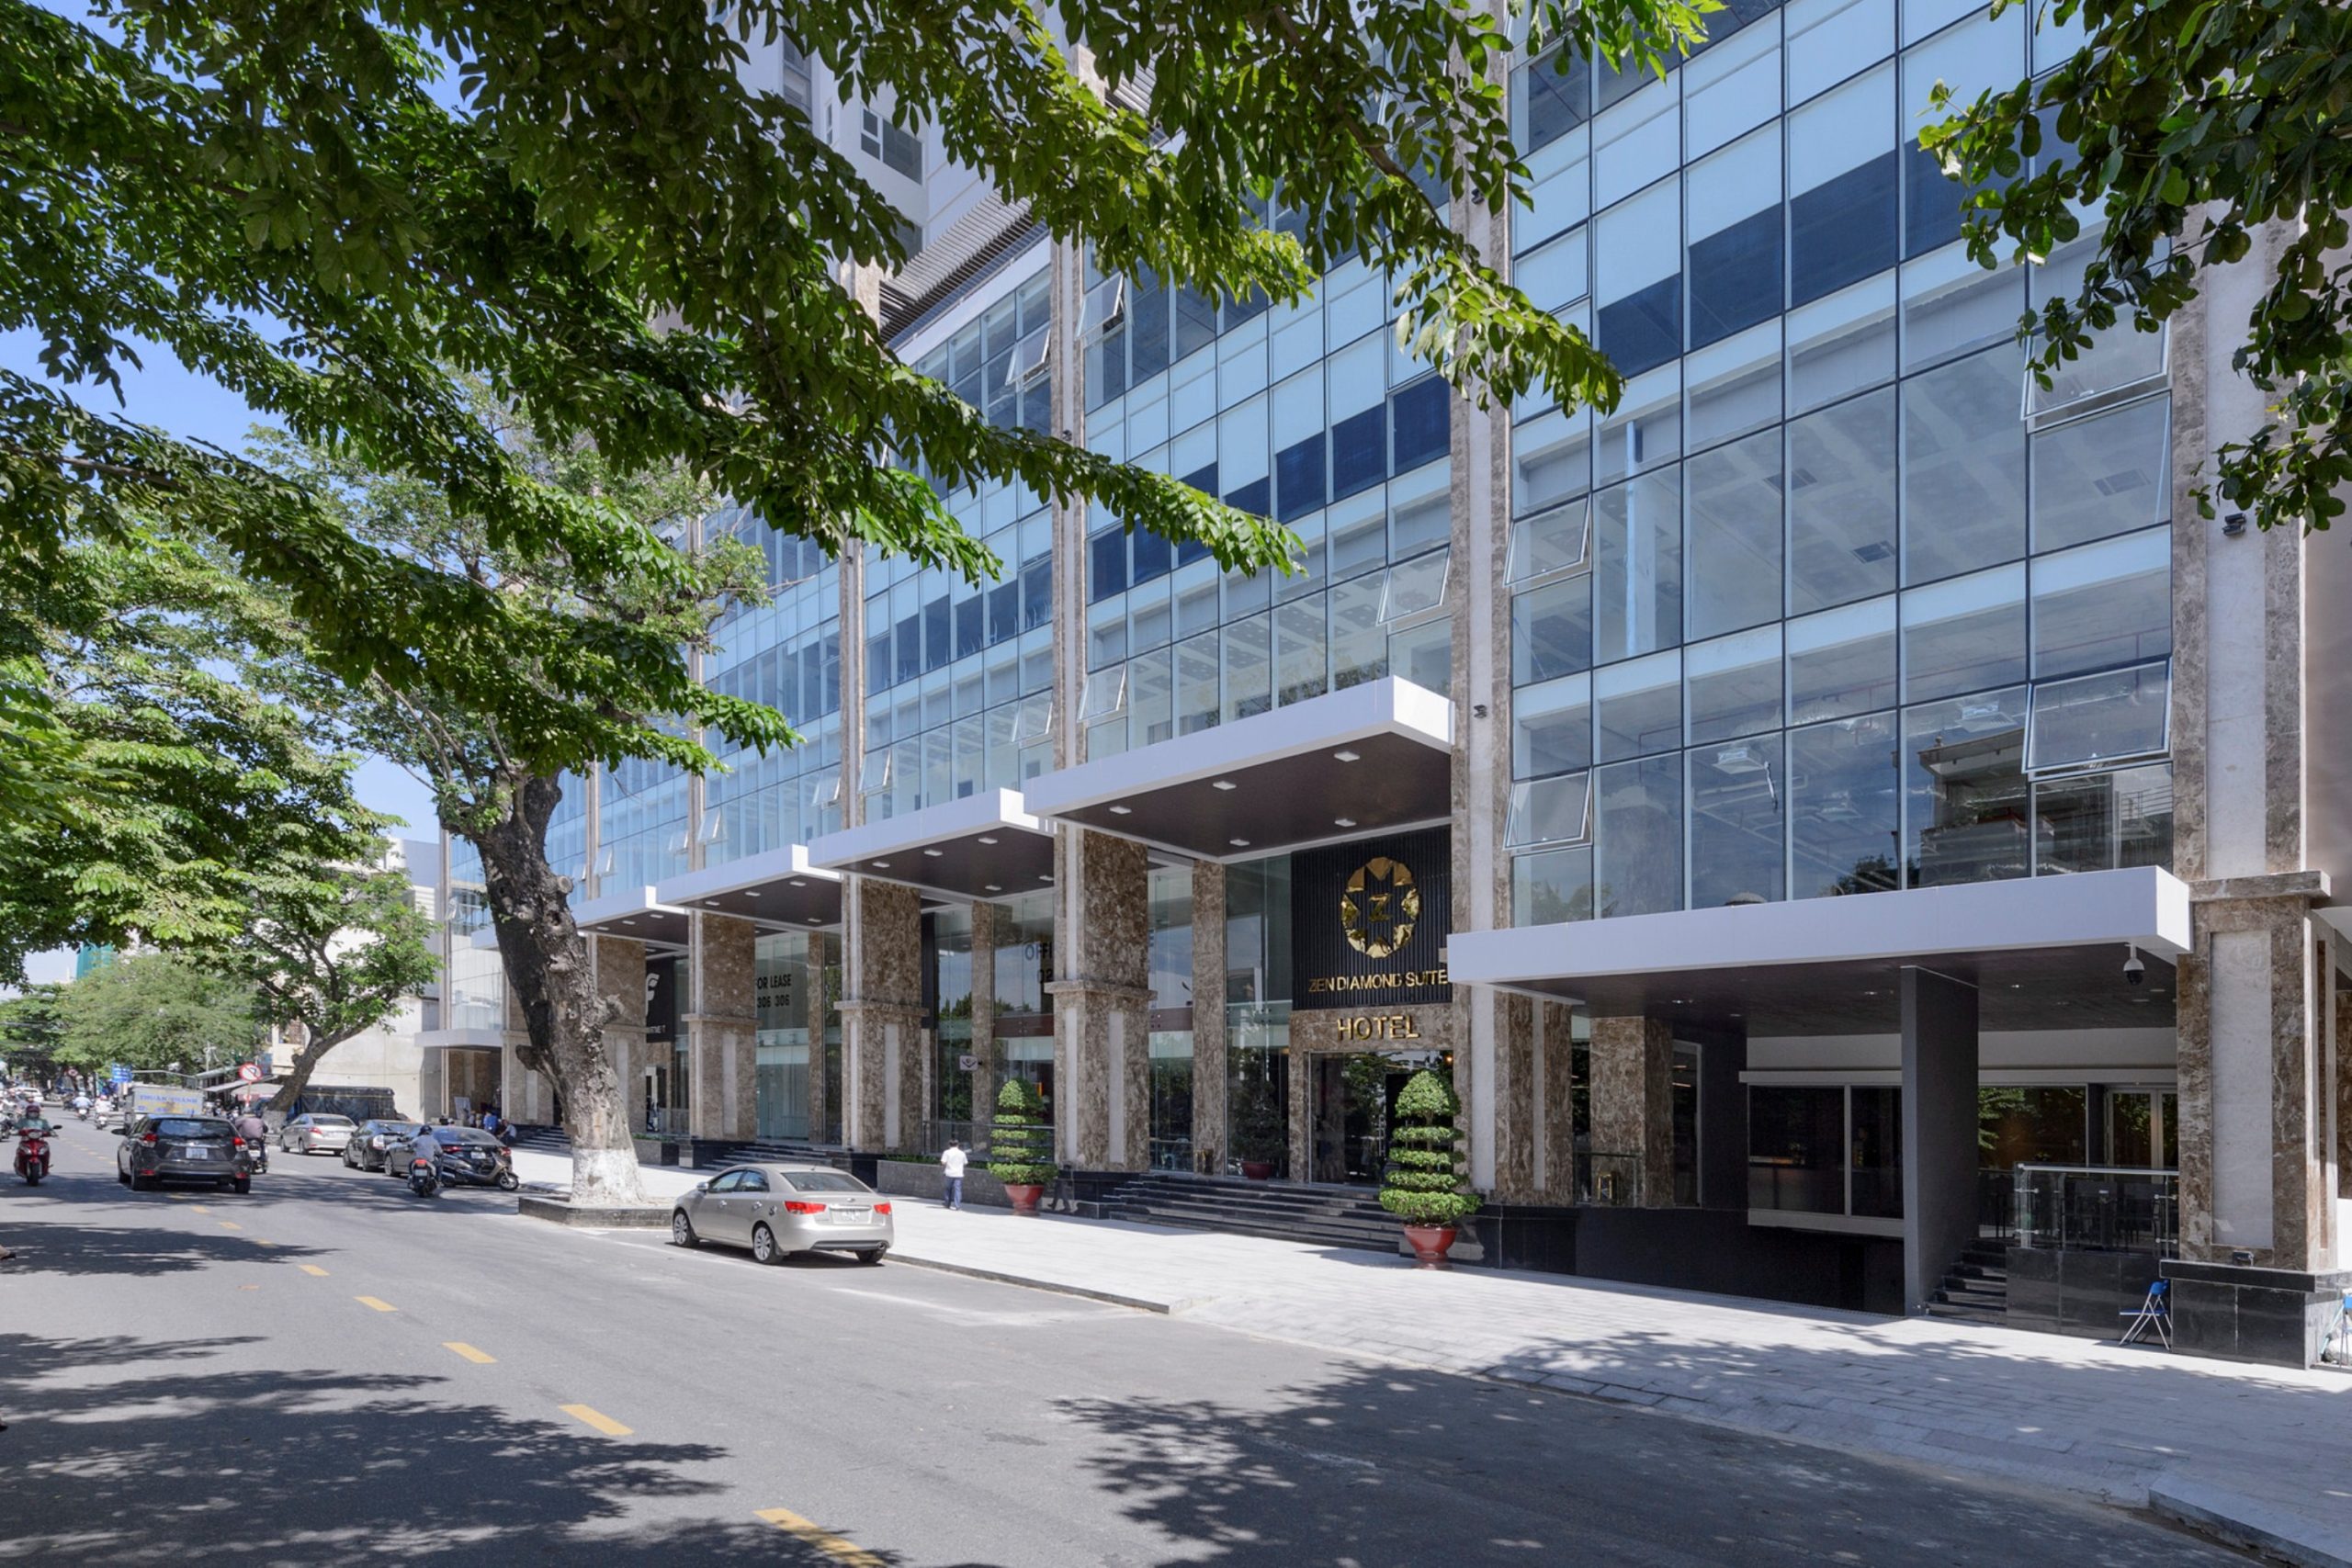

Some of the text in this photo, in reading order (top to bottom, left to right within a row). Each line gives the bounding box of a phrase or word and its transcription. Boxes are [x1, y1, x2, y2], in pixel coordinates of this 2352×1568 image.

[1368, 893, 1394, 922] Z
[754, 974, 793, 990] OR LEASE
[1308, 968, 1449, 993] ZEN DIAMOND SUITE
[1337, 1014, 1421, 1041] HOTEL
